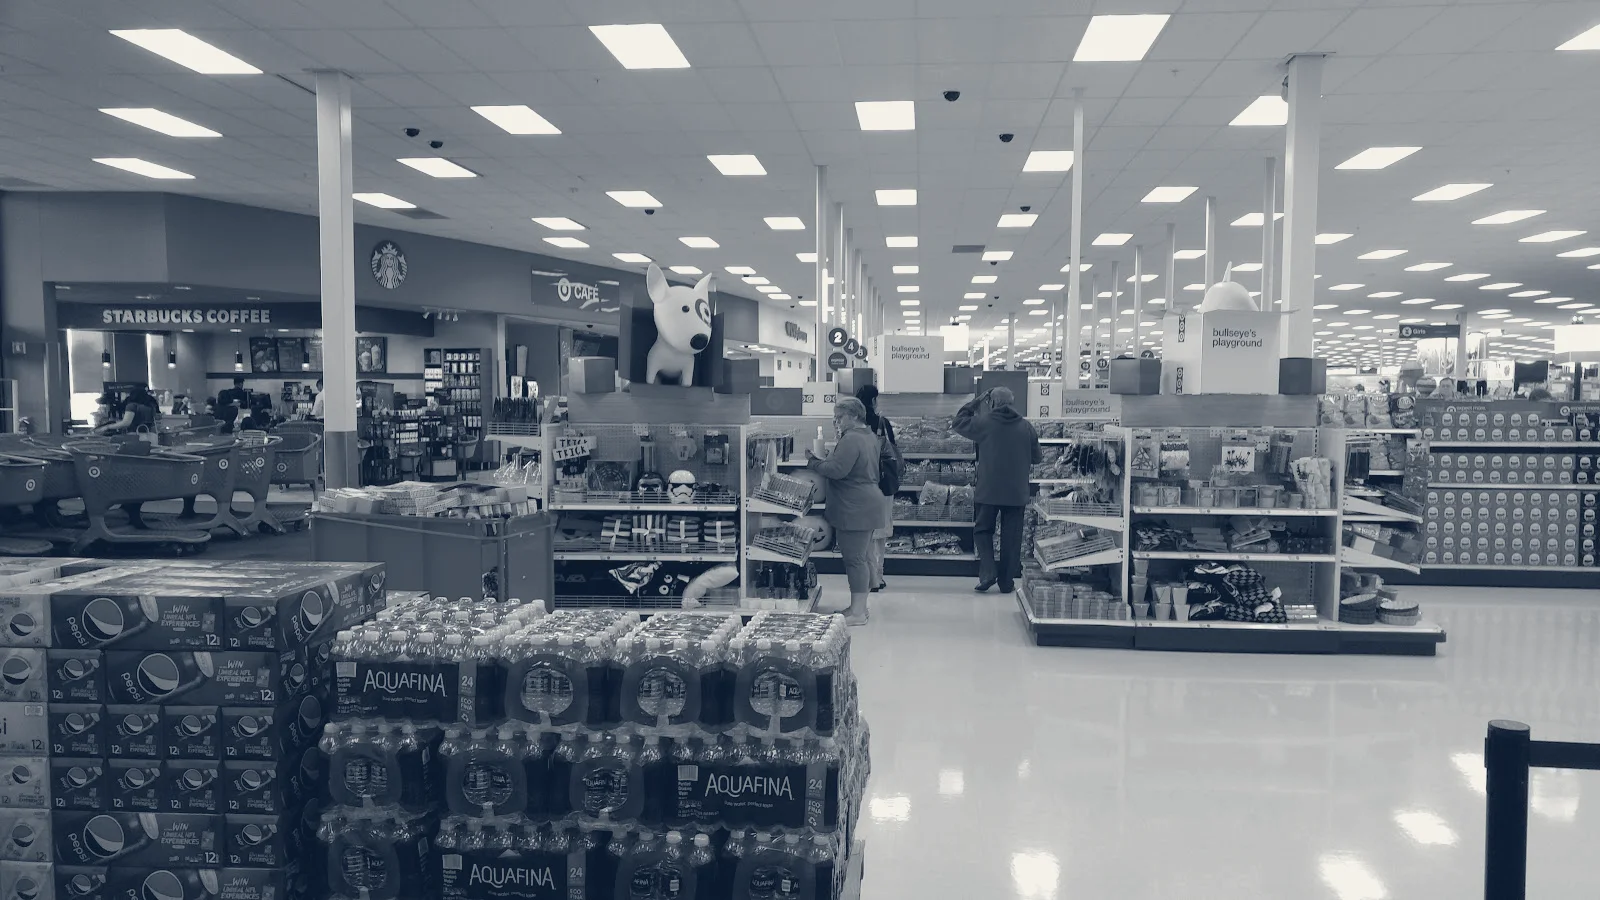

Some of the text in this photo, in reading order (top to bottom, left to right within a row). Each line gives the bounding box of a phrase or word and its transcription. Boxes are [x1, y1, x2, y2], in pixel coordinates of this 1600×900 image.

[574, 284, 599, 301] CAFÉ
[102, 309, 271, 324] STARBUCKS COFFEE
[834, 332, 843, 344] 2
[1212, 328, 1257, 339] bullseye's
[848, 342, 855, 351] 4
[1212, 337, 1263, 349] playground
[891, 345, 926, 354] bullseye's
[891, 352, 930, 361] playground
[1065, 399, 1105, 407] bullseye's
[1065, 405, 1111, 414] playground
[173, 605, 190, 613] WIN
[66, 616, 90, 646] pepsi
[290, 615, 304, 643] pepsi
[228, 660, 244, 668] WIN
[121, 672, 145, 703] pepsi
[363, 669, 447, 697] AQUAFINA
[461, 675, 474, 688] 24
[704, 773, 795, 801] AQUAFINA
[808, 778, 822, 790] 24
[172, 822, 190, 831] WIN
[68, 833, 91, 863] pepsi
[469, 863, 557, 890] AQUAFINA
[569, 867, 583, 878] 24
[232, 877, 249, 886] WIN
